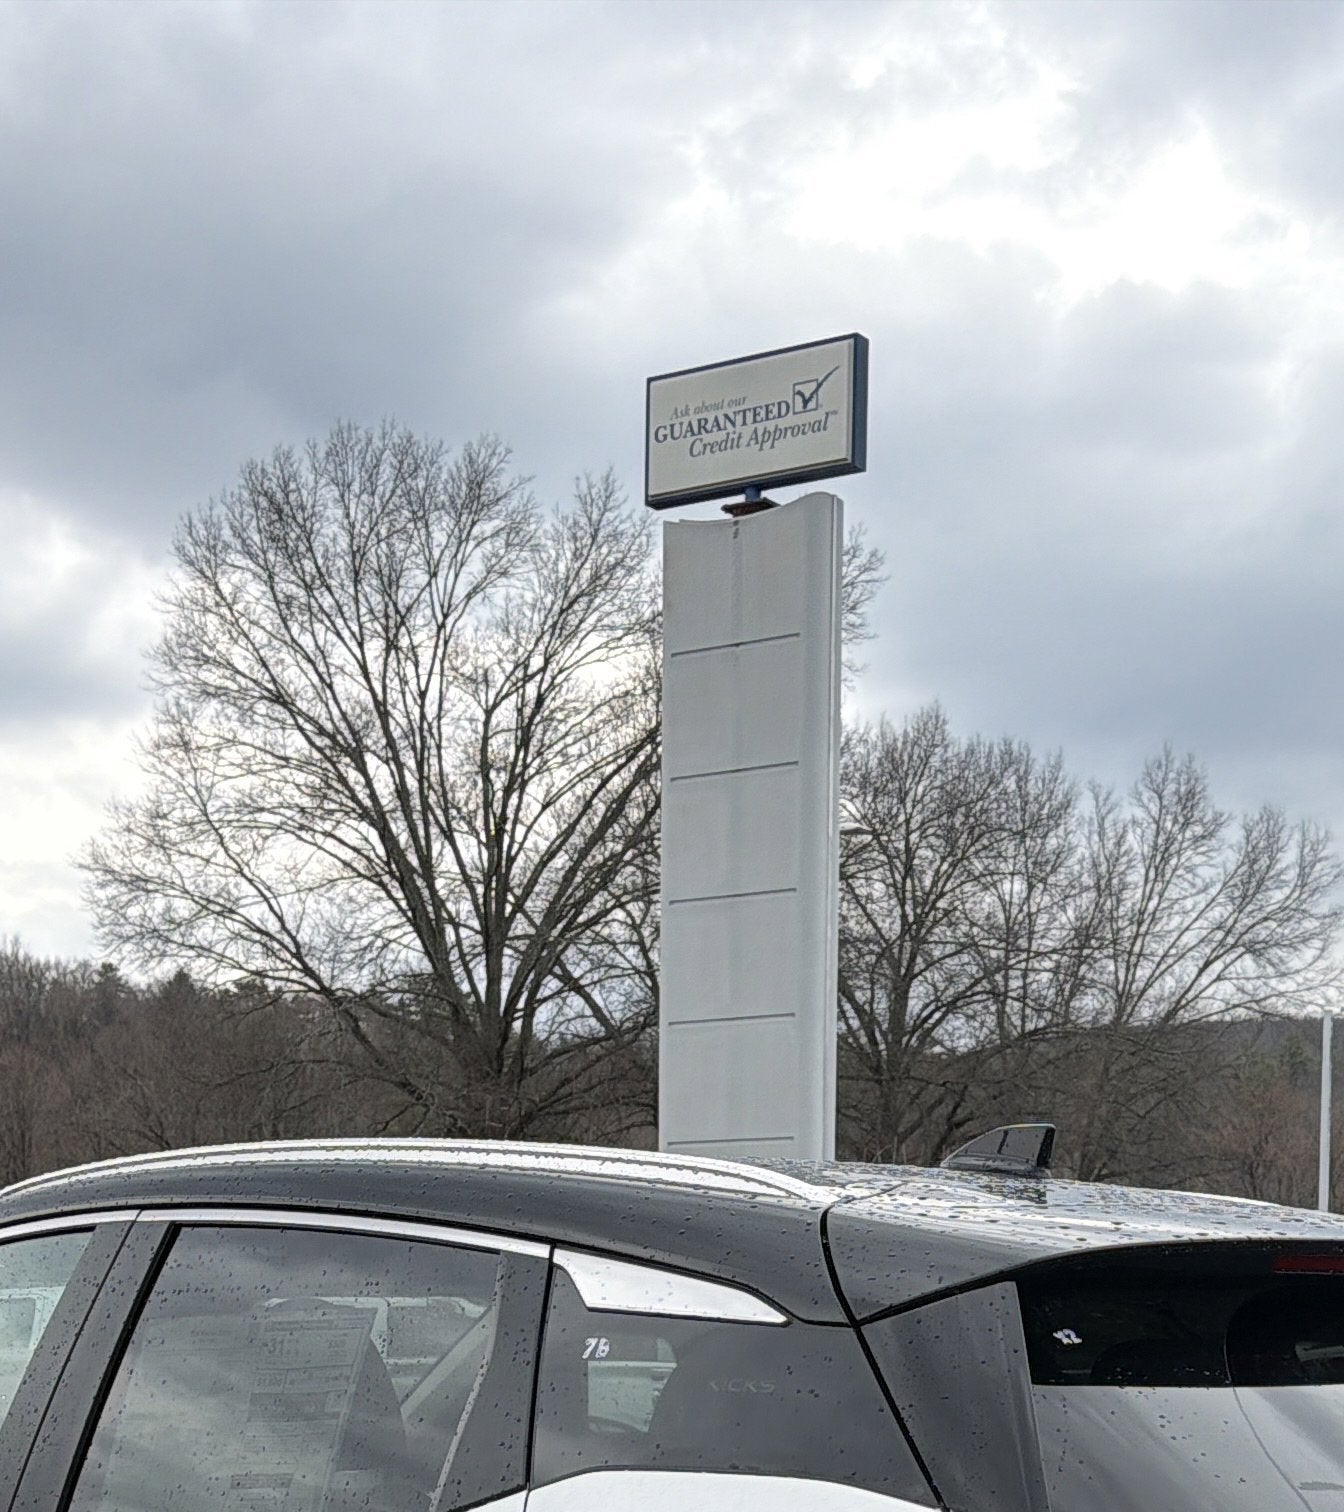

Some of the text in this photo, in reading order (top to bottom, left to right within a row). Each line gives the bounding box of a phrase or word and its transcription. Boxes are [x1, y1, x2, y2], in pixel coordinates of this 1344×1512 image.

[654, 400, 790, 443] GUARANTEED
[670, 396, 747, 420] Ask about our
[688, 430, 742, 458] Credit
